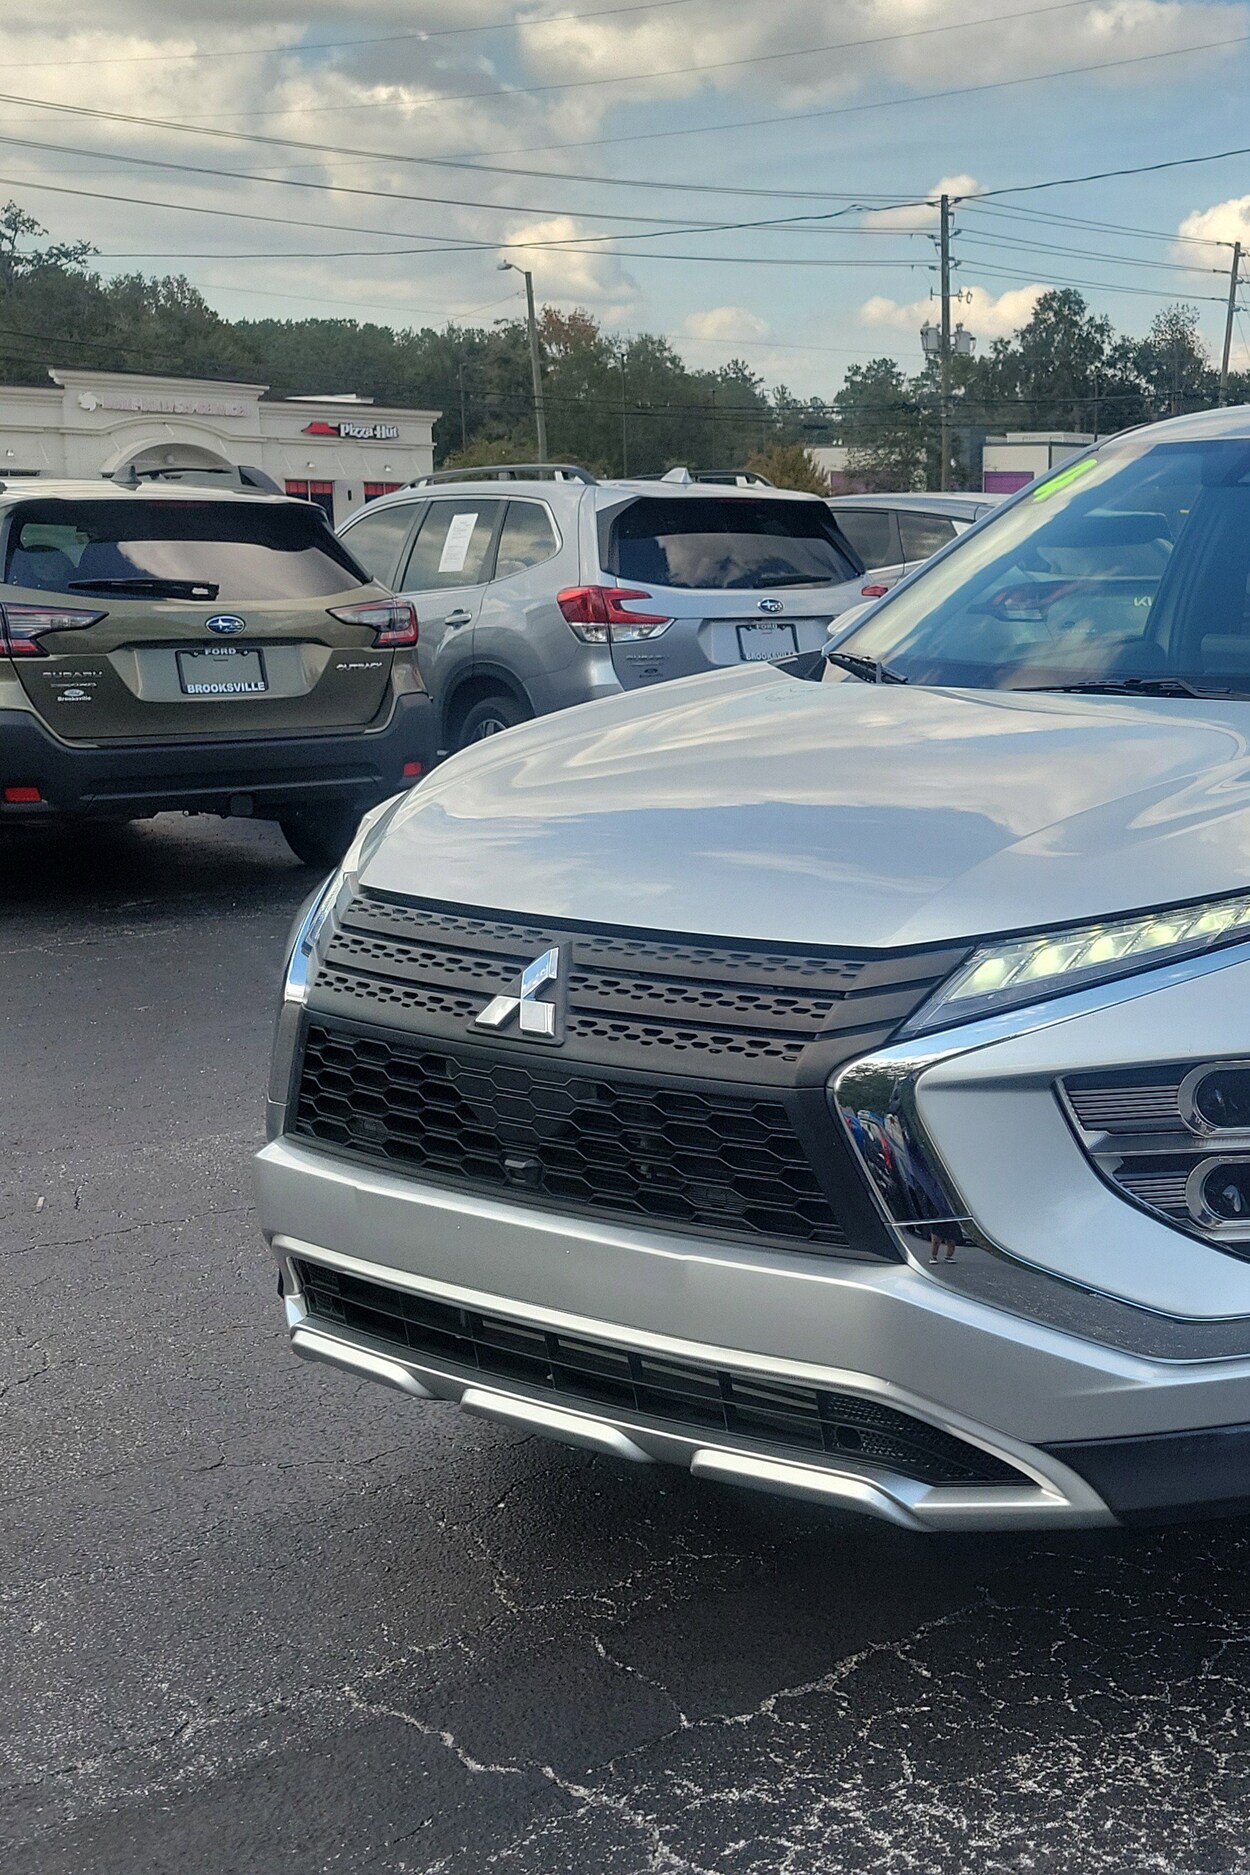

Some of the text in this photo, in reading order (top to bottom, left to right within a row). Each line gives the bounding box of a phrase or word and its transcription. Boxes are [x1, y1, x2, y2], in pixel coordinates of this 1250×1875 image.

[340, 423, 399, 439] Pizza Hut
[204, 647, 237, 655] FORD
[187, 681, 266, 694] BROOKSVILLE
